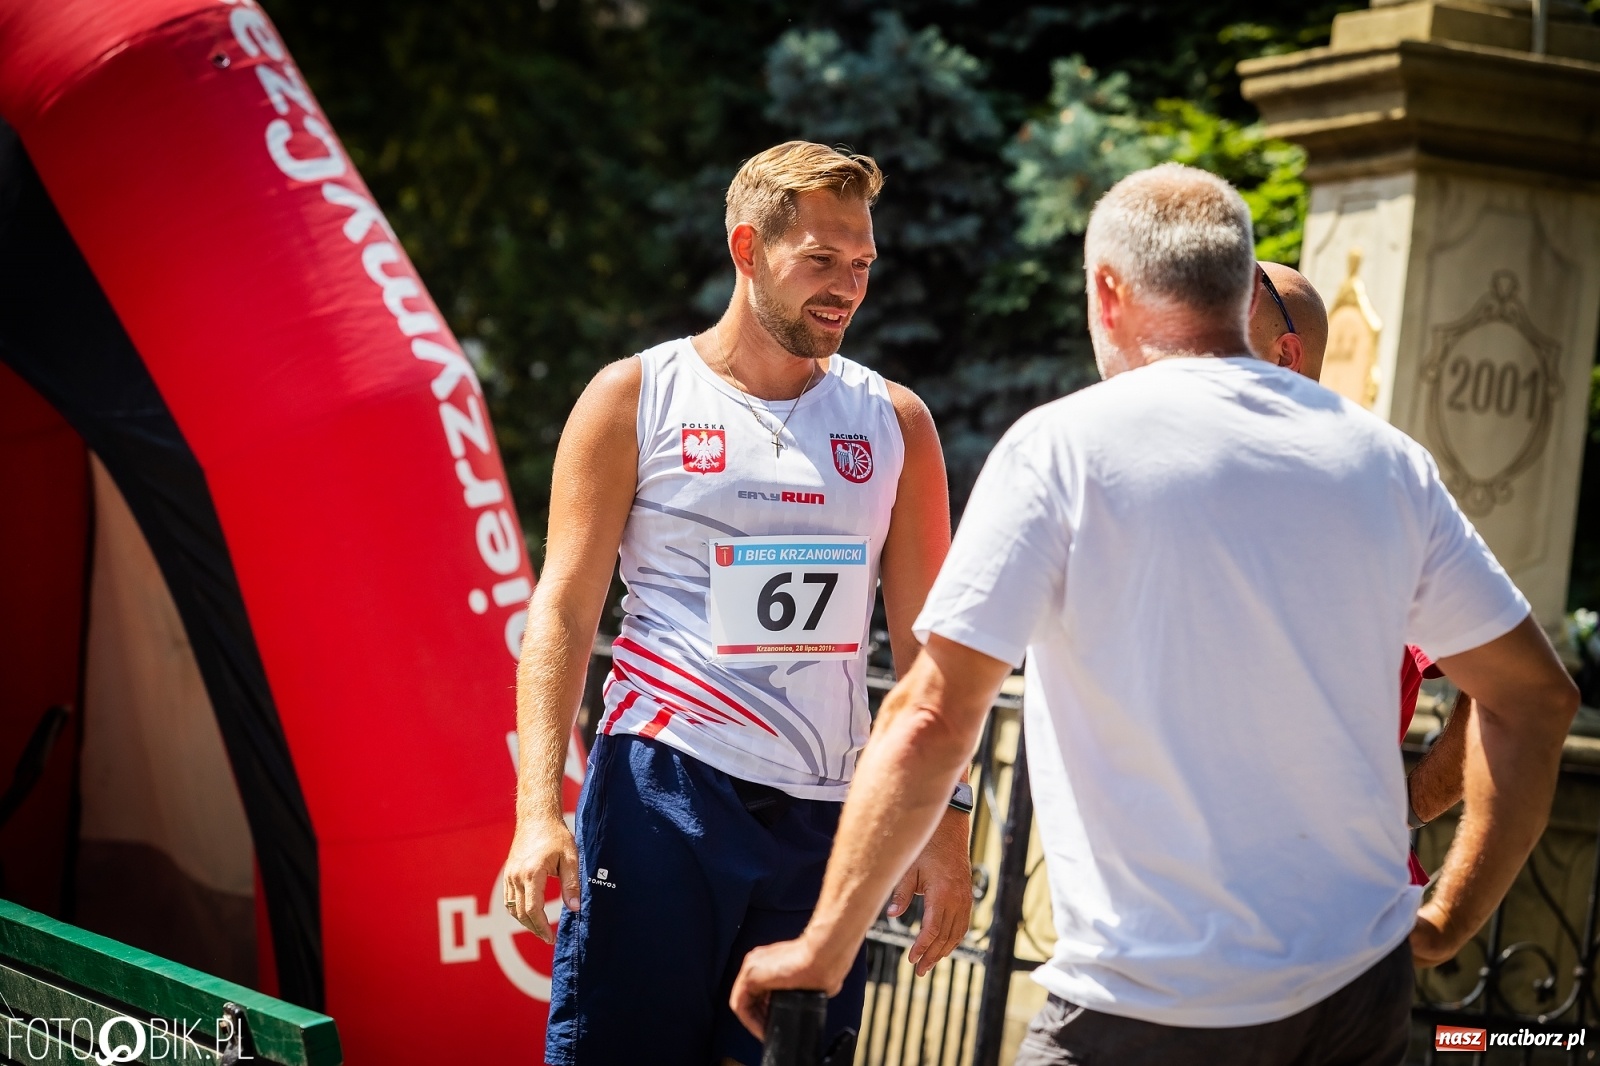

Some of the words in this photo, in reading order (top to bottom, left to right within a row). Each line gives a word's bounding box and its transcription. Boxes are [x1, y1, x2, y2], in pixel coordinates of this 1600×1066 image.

[1447, 354, 1541, 422] 2001
[681, 422, 726, 430] POLSKA
[829, 432, 869, 442] RACIBÓRZ
[737, 548, 743, 561] I
[745, 549, 777, 561] BIEG
[779, 548, 863, 561] KRZANOWICKI
[756, 571, 839, 632] 67
[756, 645, 795, 653] Krzanowice,
[804, 645, 818, 653] lipca
